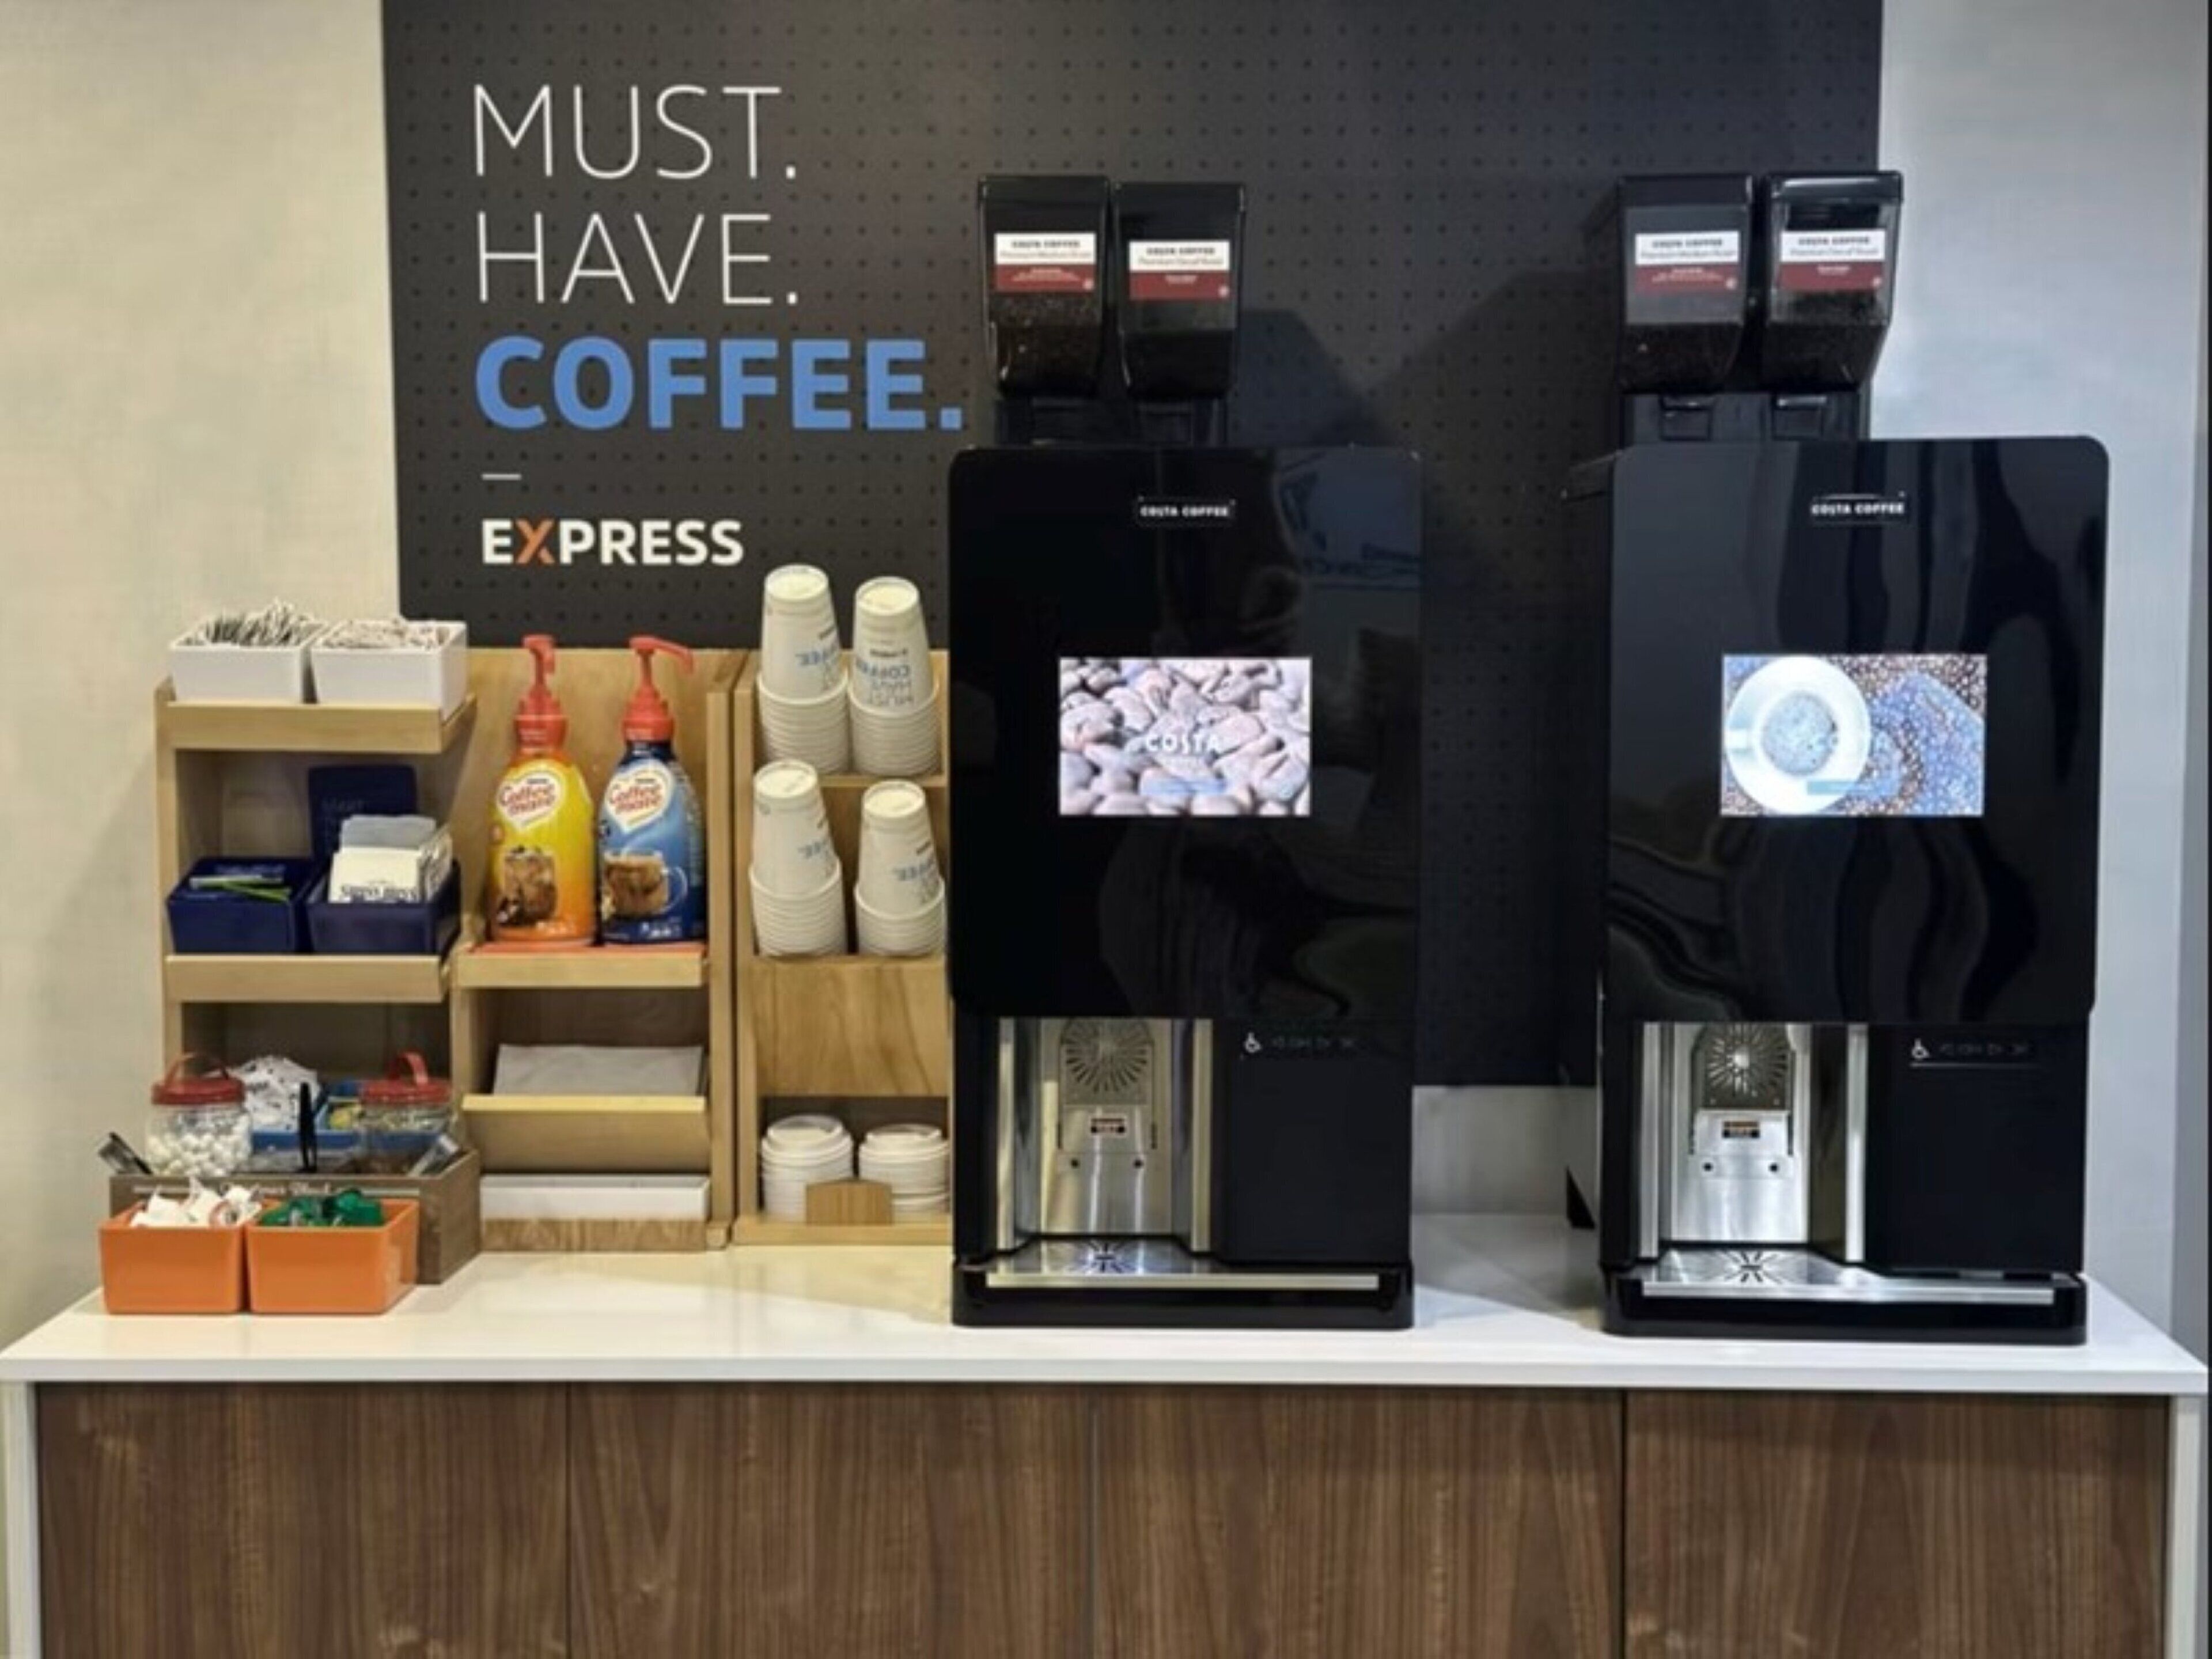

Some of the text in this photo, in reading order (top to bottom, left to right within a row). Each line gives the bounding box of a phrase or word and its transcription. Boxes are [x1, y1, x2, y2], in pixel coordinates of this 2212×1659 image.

[474, 84, 797, 180] MUST.
[478, 212, 798, 305] HAVE.
[476, 336, 963, 430] COFFEE.
[1140, 504, 1228, 518] COSTA COFFEE
[1811, 502, 1904, 516] COSTA COFFEE
[482, 519, 744, 566] EXPRESS
[1146, 734, 1221, 754] COSTA
